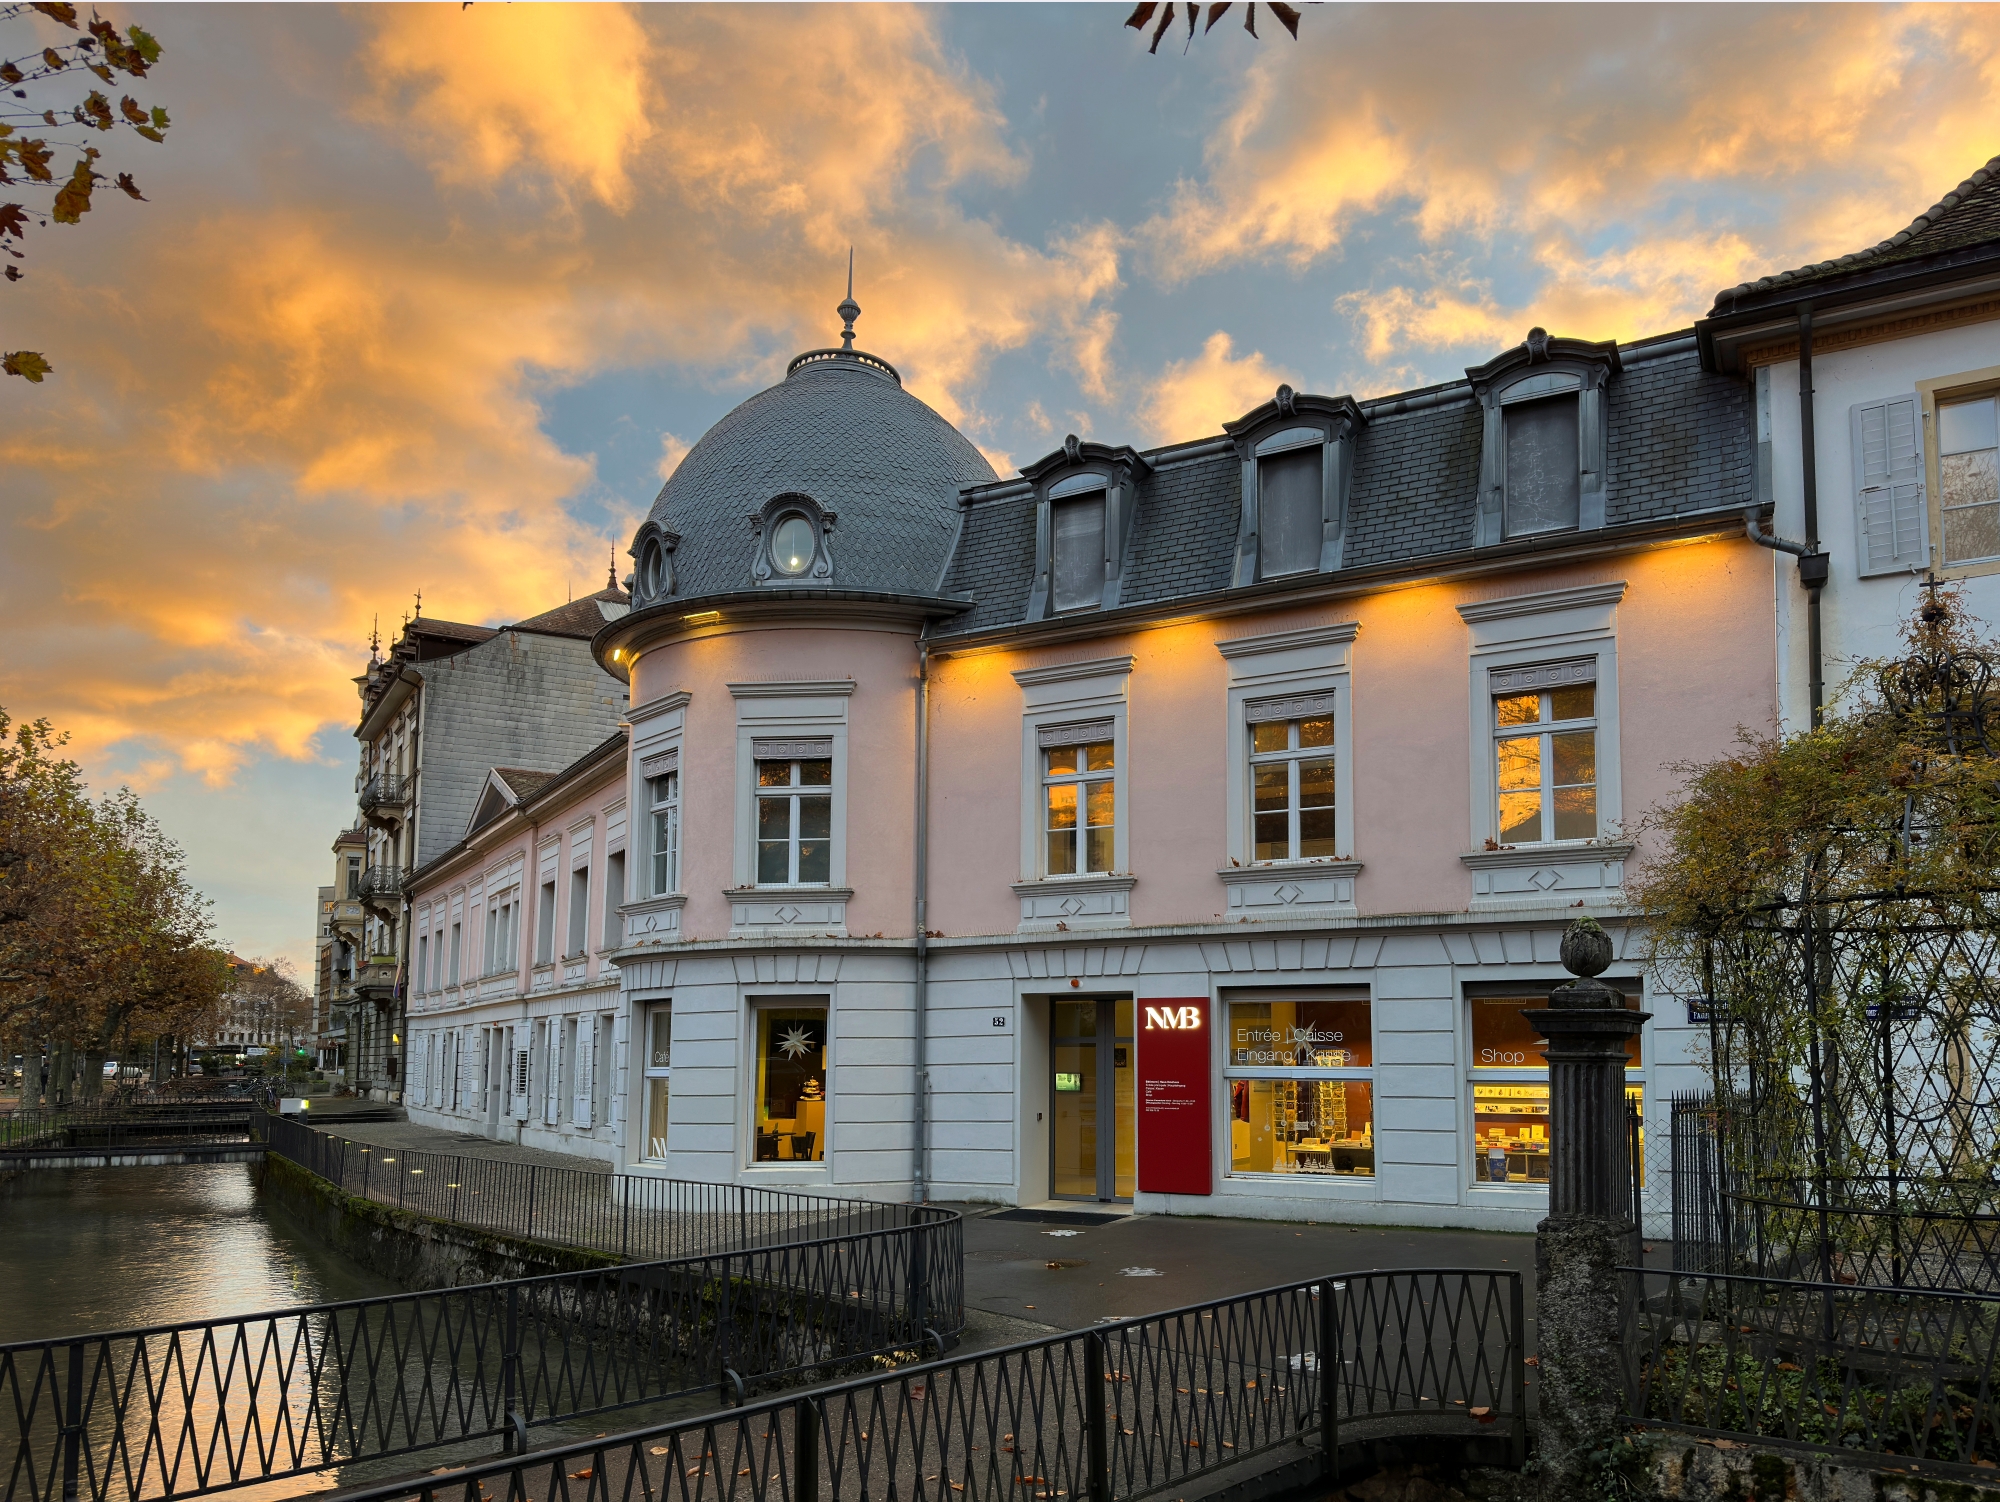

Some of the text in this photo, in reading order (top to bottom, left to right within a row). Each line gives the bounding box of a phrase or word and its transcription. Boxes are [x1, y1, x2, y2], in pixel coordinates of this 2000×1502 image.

[994, 1017, 1004, 1026] 52
[1145, 1006, 1201, 1029] NMB
[1237, 1028, 1281, 1042] Entrée
[1294, 1028, 1344, 1042] Caisse
[655, 1050, 670, 1063] Café
[1237, 1047, 1293, 1064] Eingang
[1481, 1048, 1525, 1066] Shop
